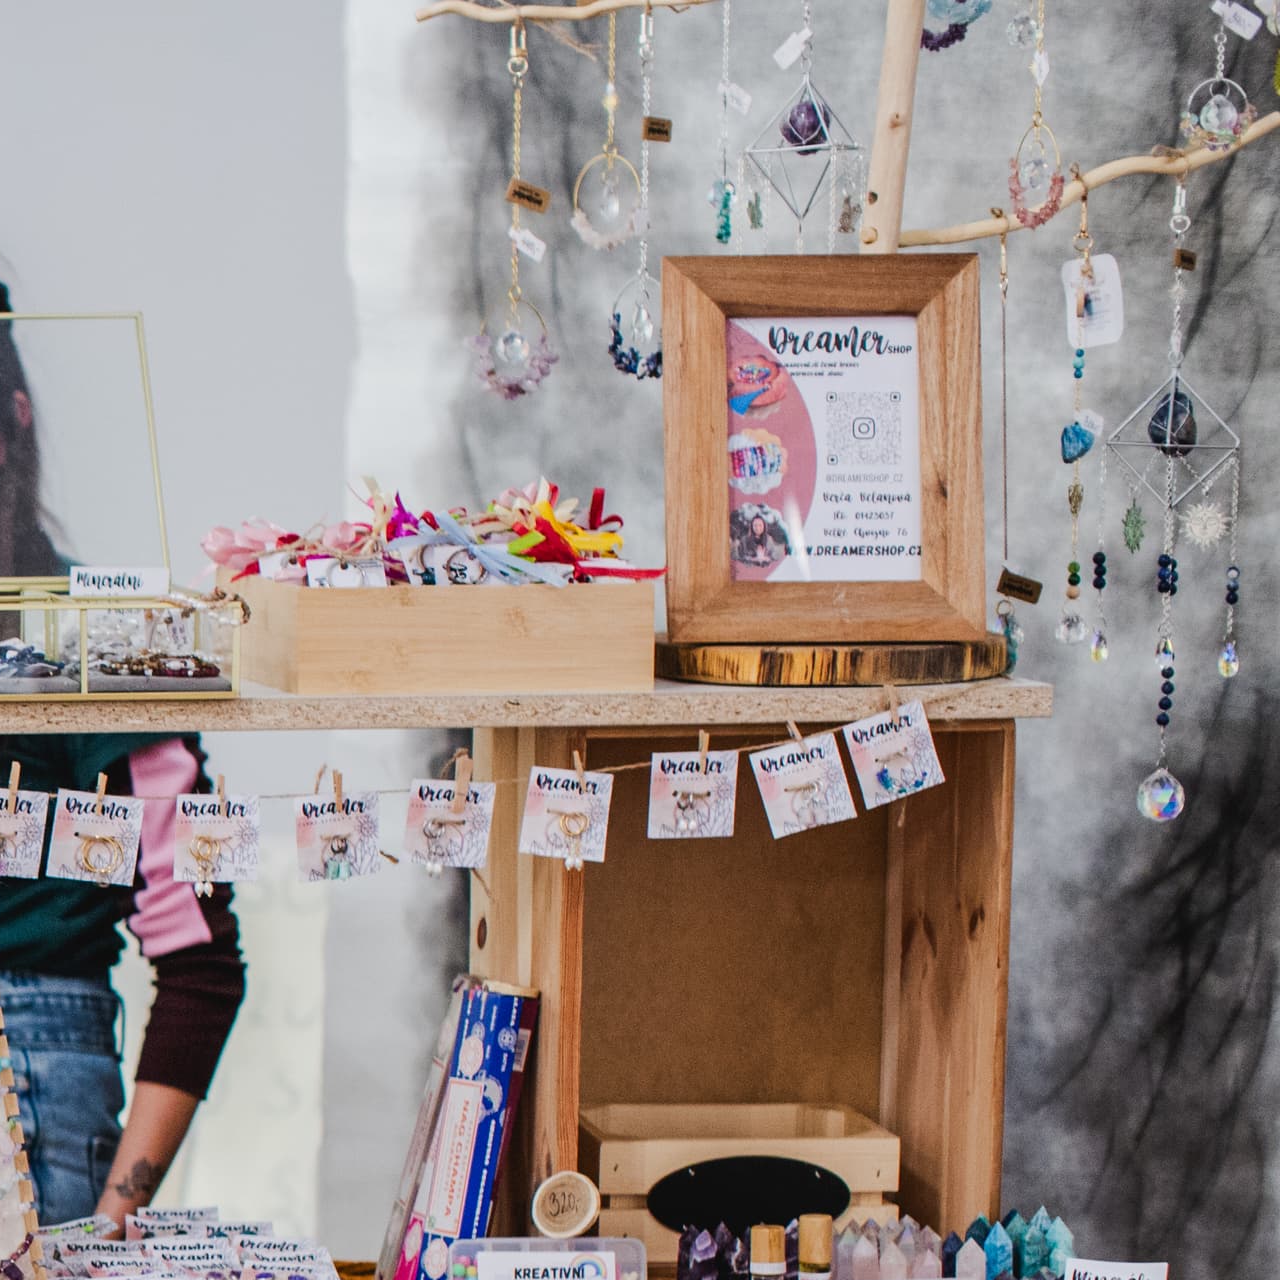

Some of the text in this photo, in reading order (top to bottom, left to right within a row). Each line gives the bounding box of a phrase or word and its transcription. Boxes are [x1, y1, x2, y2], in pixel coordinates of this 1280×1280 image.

[768, 325, 912, 358] Dreamer SHOP
[418, 785, 481, 804] Dreaer
[459, 1099, 470, 1137] NAG
[444, 1142, 463, 1217] CHAMPA
